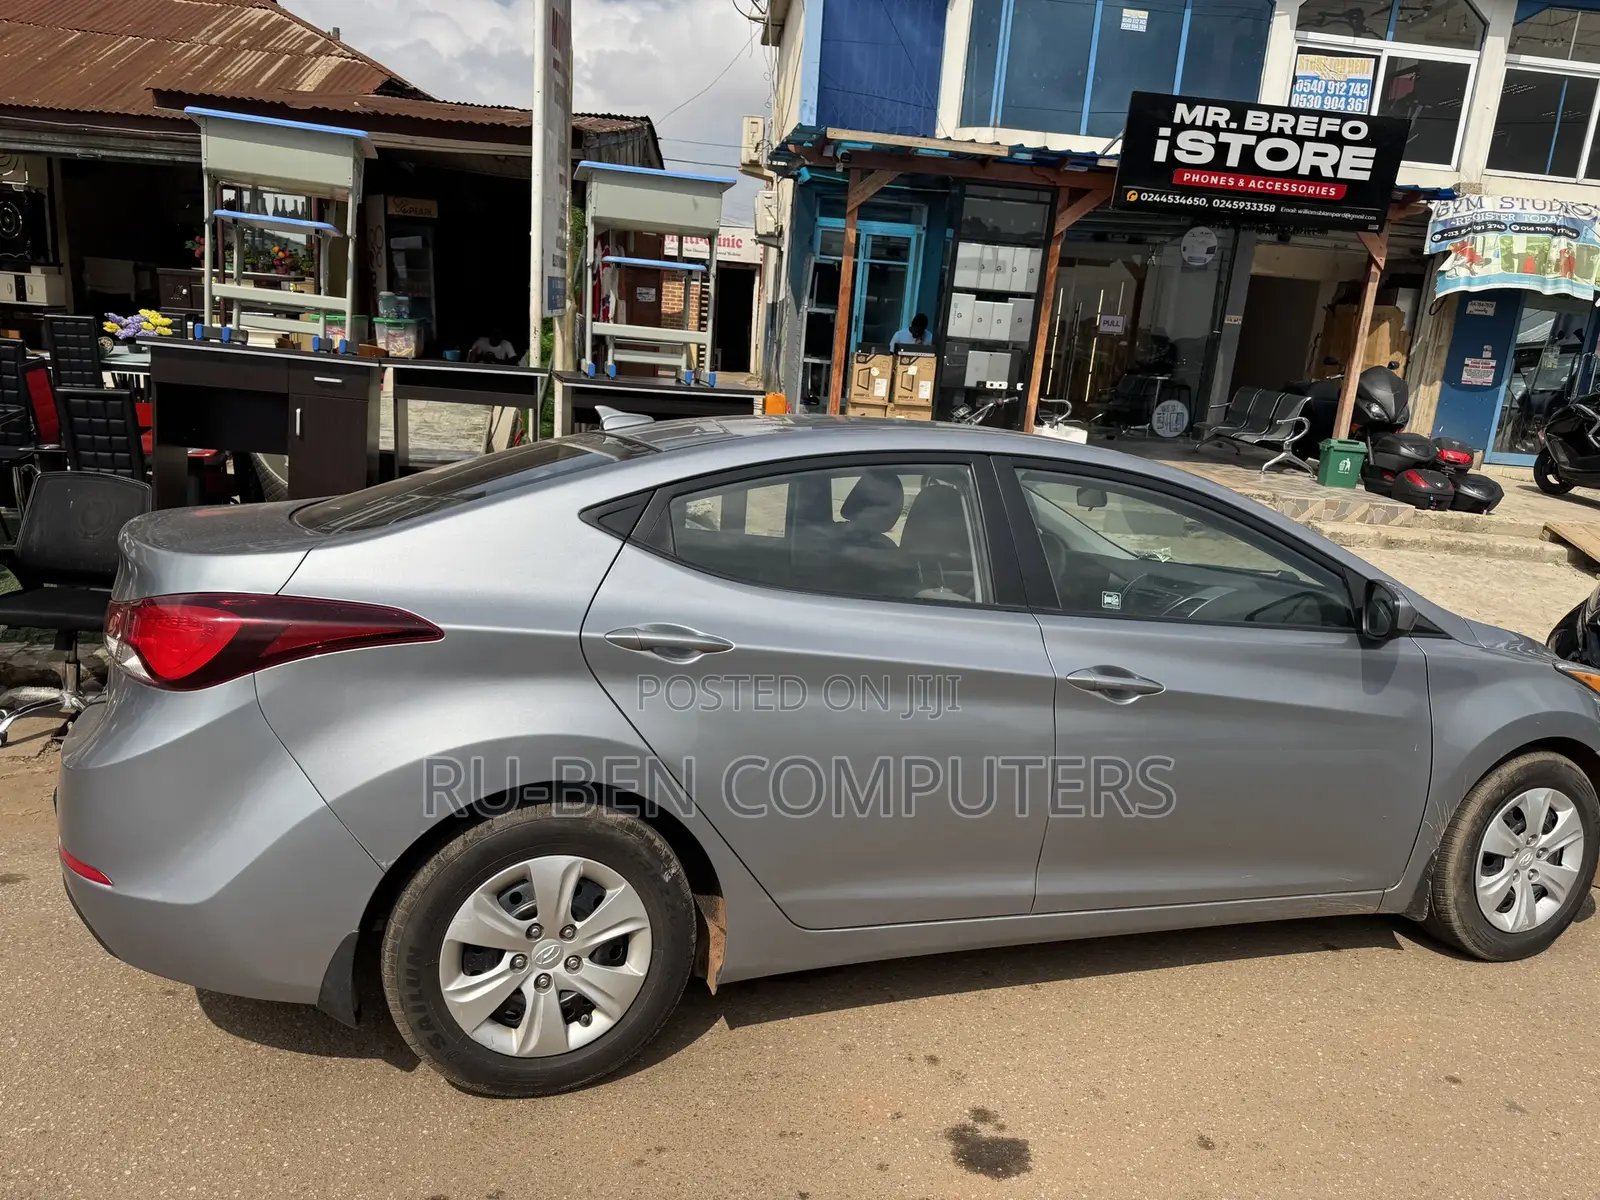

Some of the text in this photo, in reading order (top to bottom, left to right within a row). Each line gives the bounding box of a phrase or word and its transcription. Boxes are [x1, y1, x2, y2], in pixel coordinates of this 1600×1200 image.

[1296, 79, 1369, 97] 0540 912 743
[1292, 93, 1369, 112] 0530 904 361
[1173, 102, 1369, 141] MR. BREFO
[1153, 127, 1377, 181] iSTORE
[1183, 172, 1337, 197] PHONES & ACCESSORIES
[1140, 192, 1209, 209] 0244534650,
[1212, 198, 1276, 214] 0245933358
[1103, 319, 1121, 327] PULL
